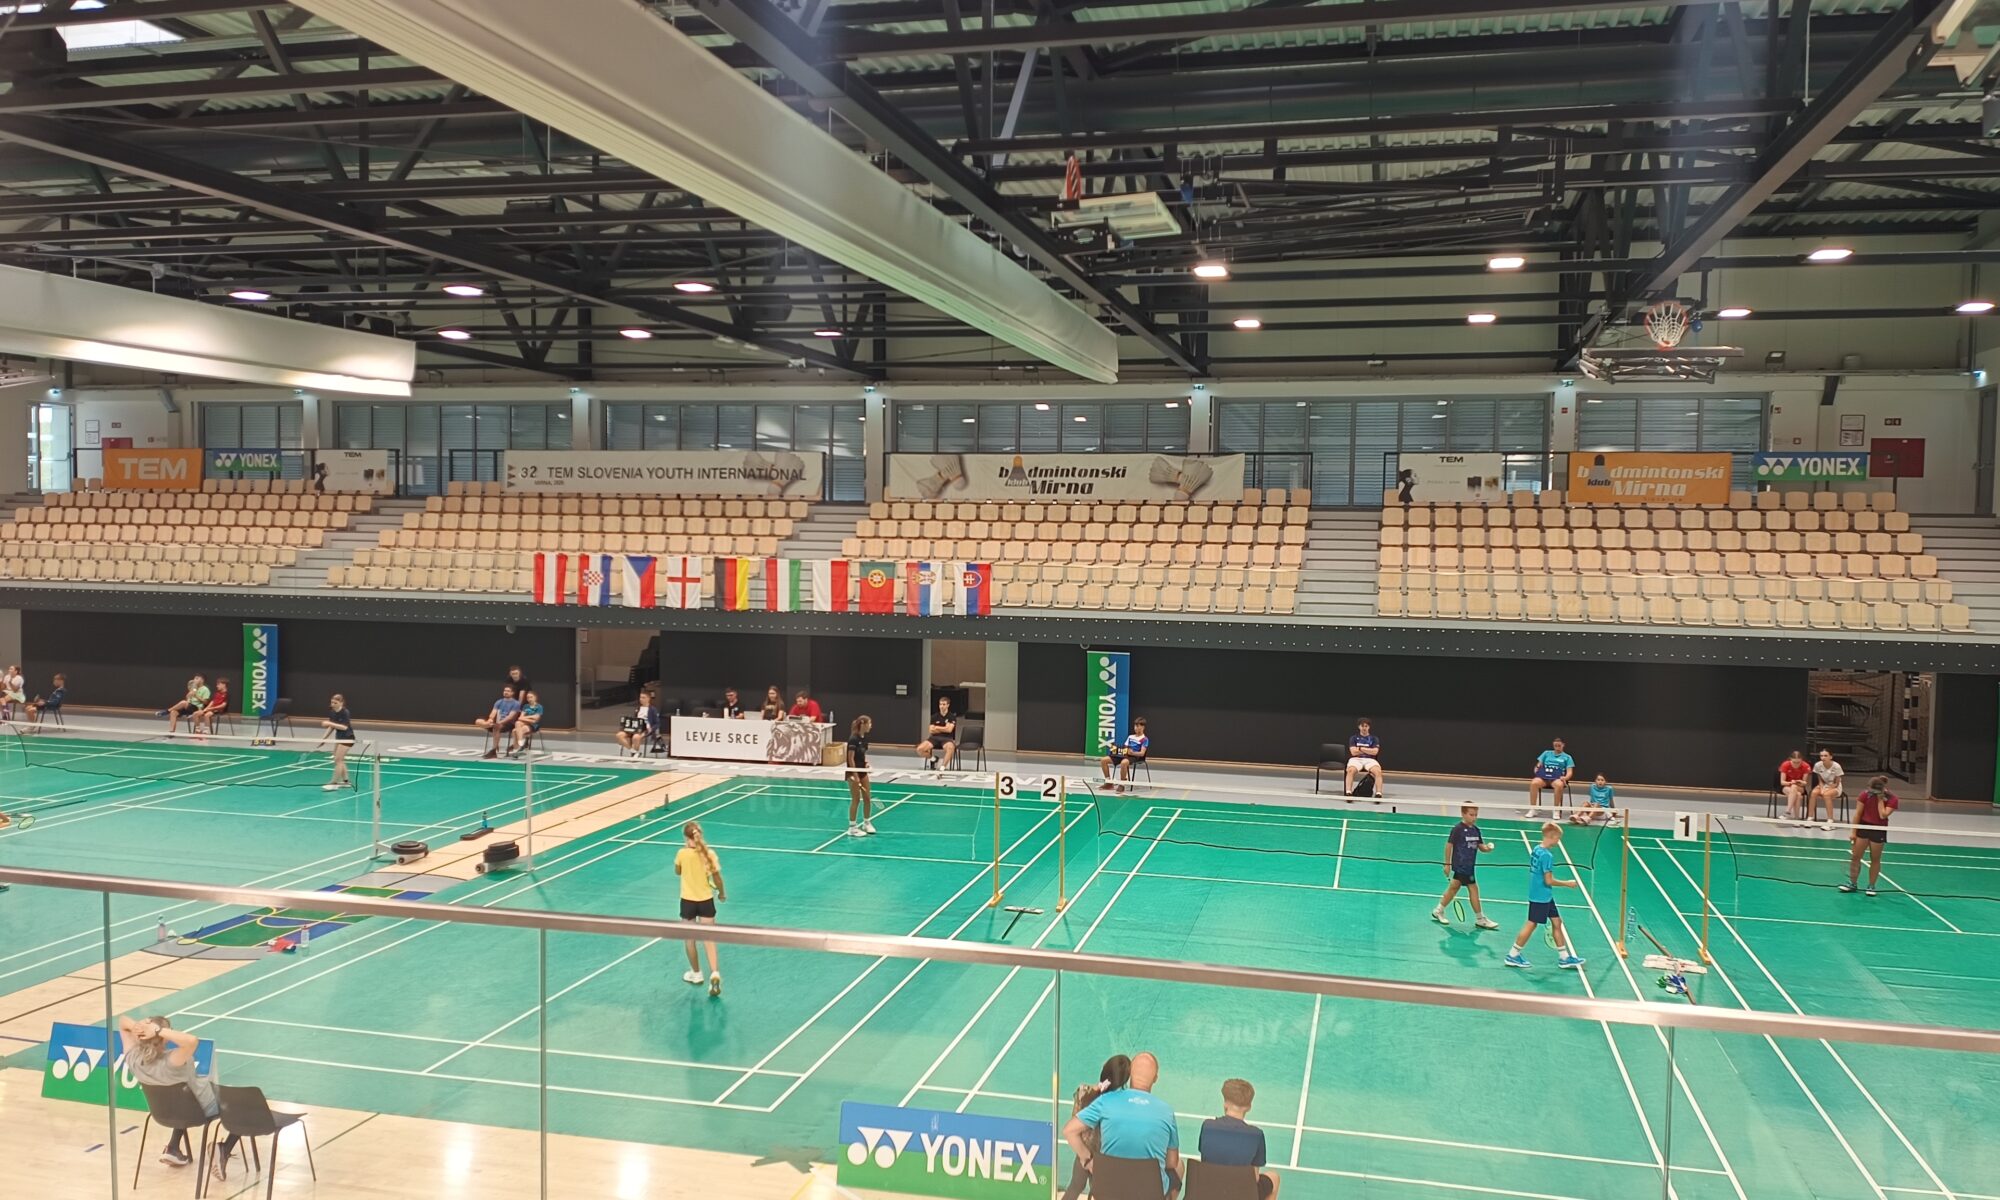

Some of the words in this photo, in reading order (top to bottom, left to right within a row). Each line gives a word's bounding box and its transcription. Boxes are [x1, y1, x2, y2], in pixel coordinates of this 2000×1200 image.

[238, 452, 277, 467] YONEX
[1797, 457, 1861, 476] YONEX
[118, 457, 187, 480] TEM
[520, 465, 538, 478] 32
[547, 466, 573, 478] TEM
[577, 467, 643, 479] SLOVENIA
[646, 467, 693, 479] YOUTH
[697, 467, 807, 481] INTERNATIONAL
[998, 466, 1127, 479] bdmintonski
[1576, 465, 1725, 479] bdmintonski
[1029, 480, 1094, 495] Mirna
[1587, 478, 1611, 487] klub
[1612, 480, 1687, 496] Mirna
[252, 659, 267, 710] YONEX
[1098, 692, 1117, 749] YONEX
[685, 731, 721, 743] LEVJE
[727, 733, 759, 745] SRCE
[1000, 775, 1014, 796] 3
[1042, 777, 1057, 798] 2
[1679, 815, 1690, 837] 1
[920, 1132, 1040, 1184] YONEX
